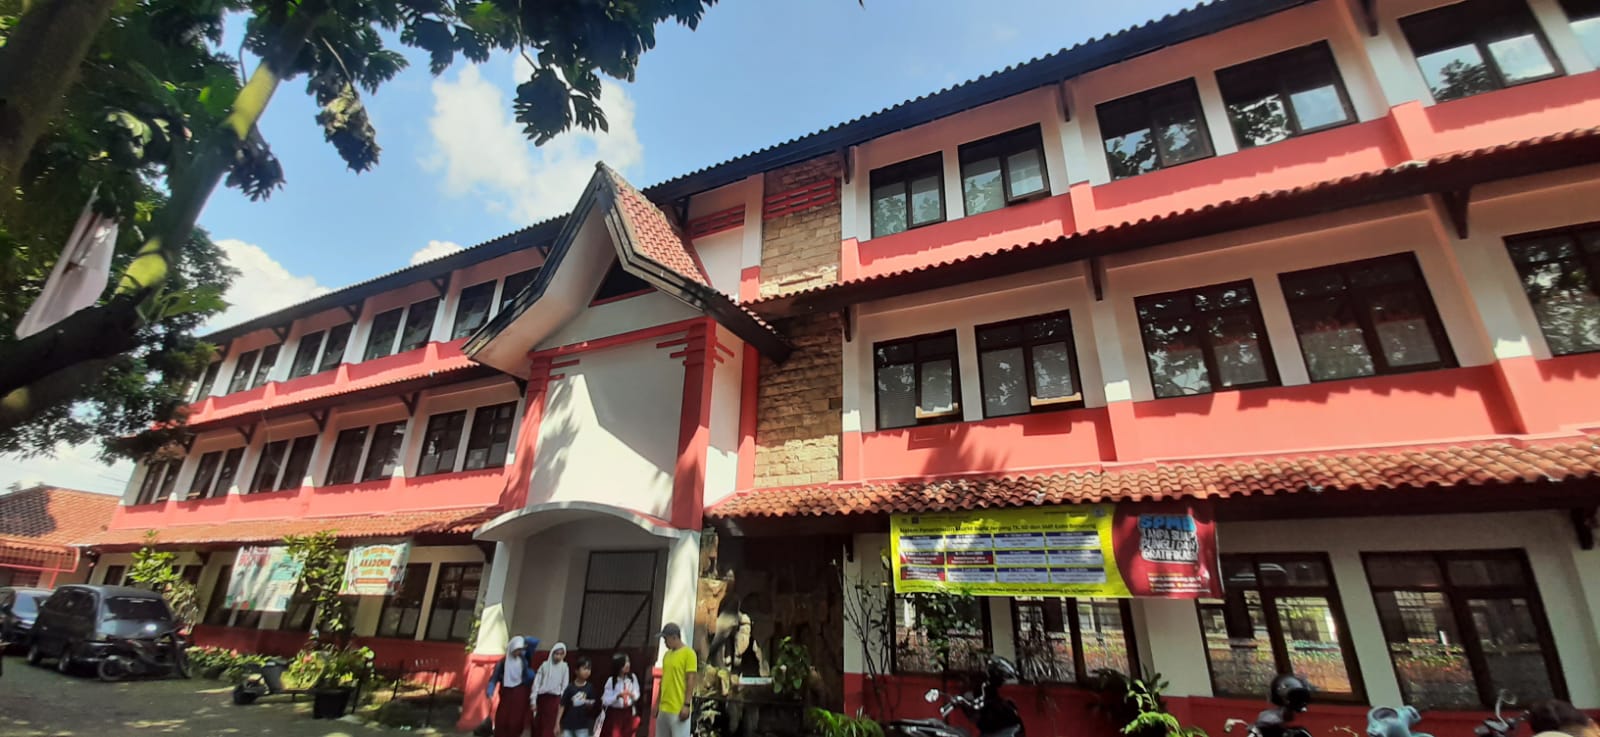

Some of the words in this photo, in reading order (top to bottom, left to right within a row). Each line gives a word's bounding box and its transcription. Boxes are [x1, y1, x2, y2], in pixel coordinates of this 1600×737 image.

[1140, 516, 1194, 531] SPMB
[1143, 528, 1170, 541] TANPA
[1142, 539, 1175, 551] PUNGLI
[1176, 540, 1197, 552] DAN
